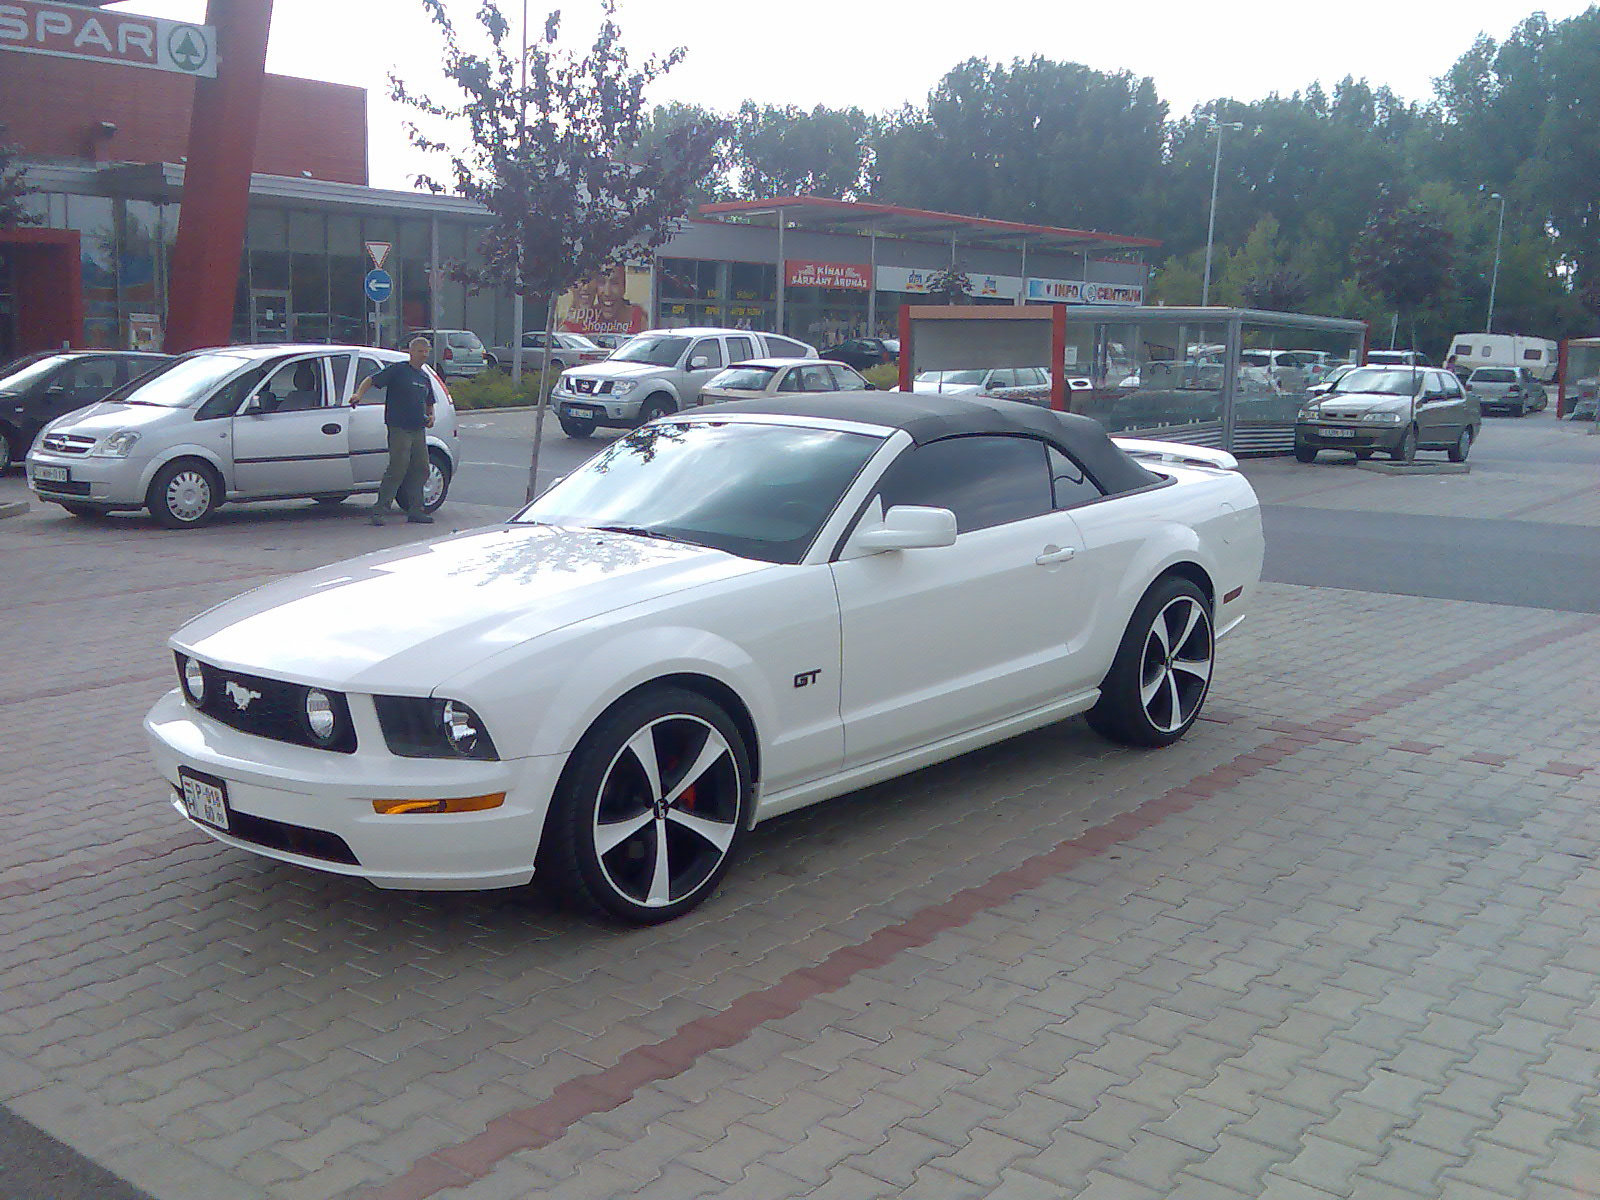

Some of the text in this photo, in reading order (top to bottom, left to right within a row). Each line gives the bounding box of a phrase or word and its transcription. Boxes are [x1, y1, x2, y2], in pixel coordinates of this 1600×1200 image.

[0, 4, 153, 58] SPAR
[1054, 283, 1079, 298] INFO
[793, 668, 822, 688] GT
